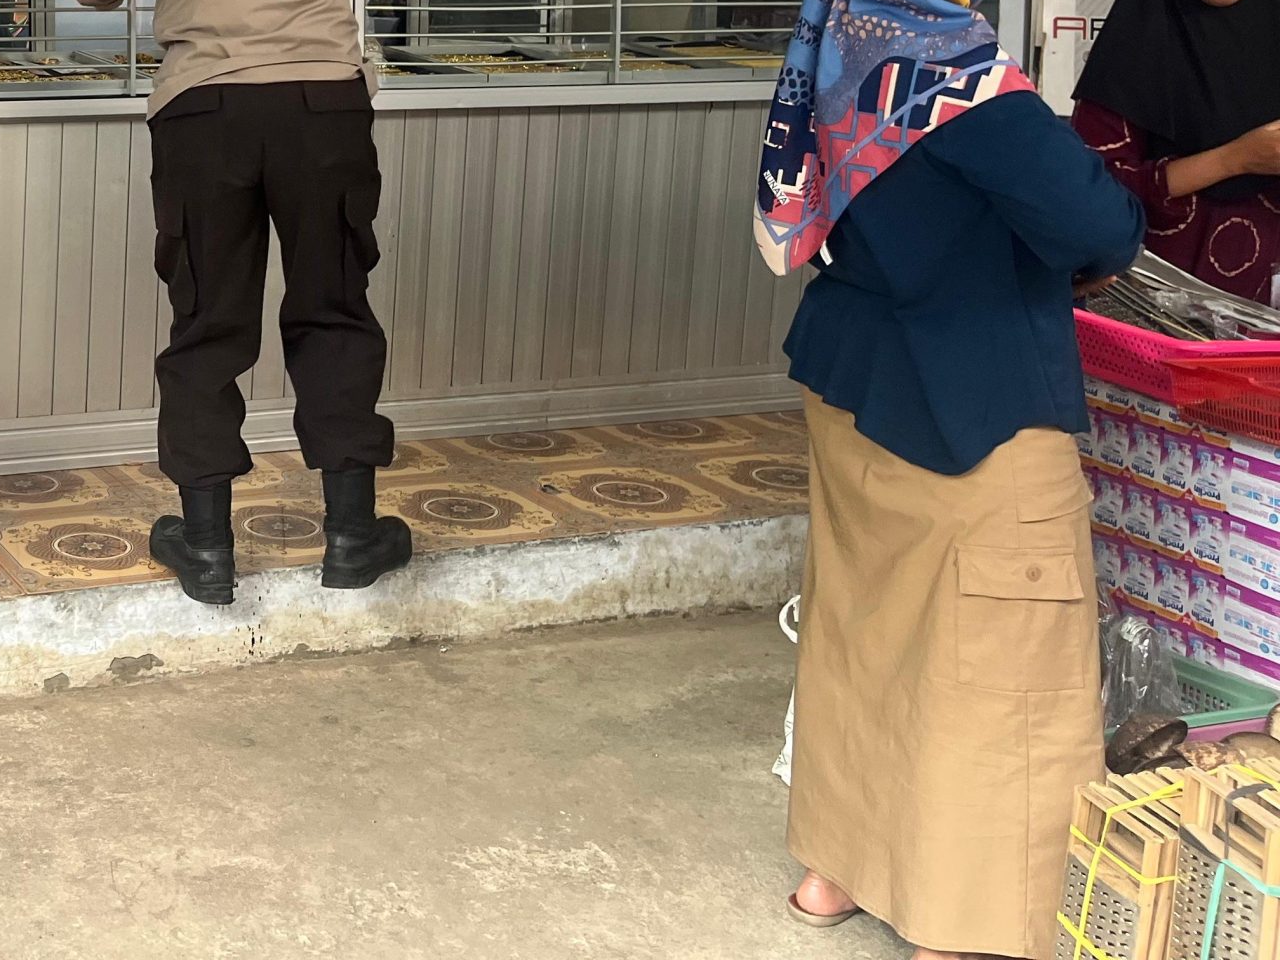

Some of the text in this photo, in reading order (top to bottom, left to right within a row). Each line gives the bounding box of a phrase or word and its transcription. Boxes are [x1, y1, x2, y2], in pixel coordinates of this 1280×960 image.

[1193, 484, 1221, 501] Proclin
[1158, 534, 1185, 552] Proclin
[1193, 546, 1220, 564] Proclin
[1157, 595, 1184, 613] Proclin
[1191, 609, 1215, 627] Proclin
